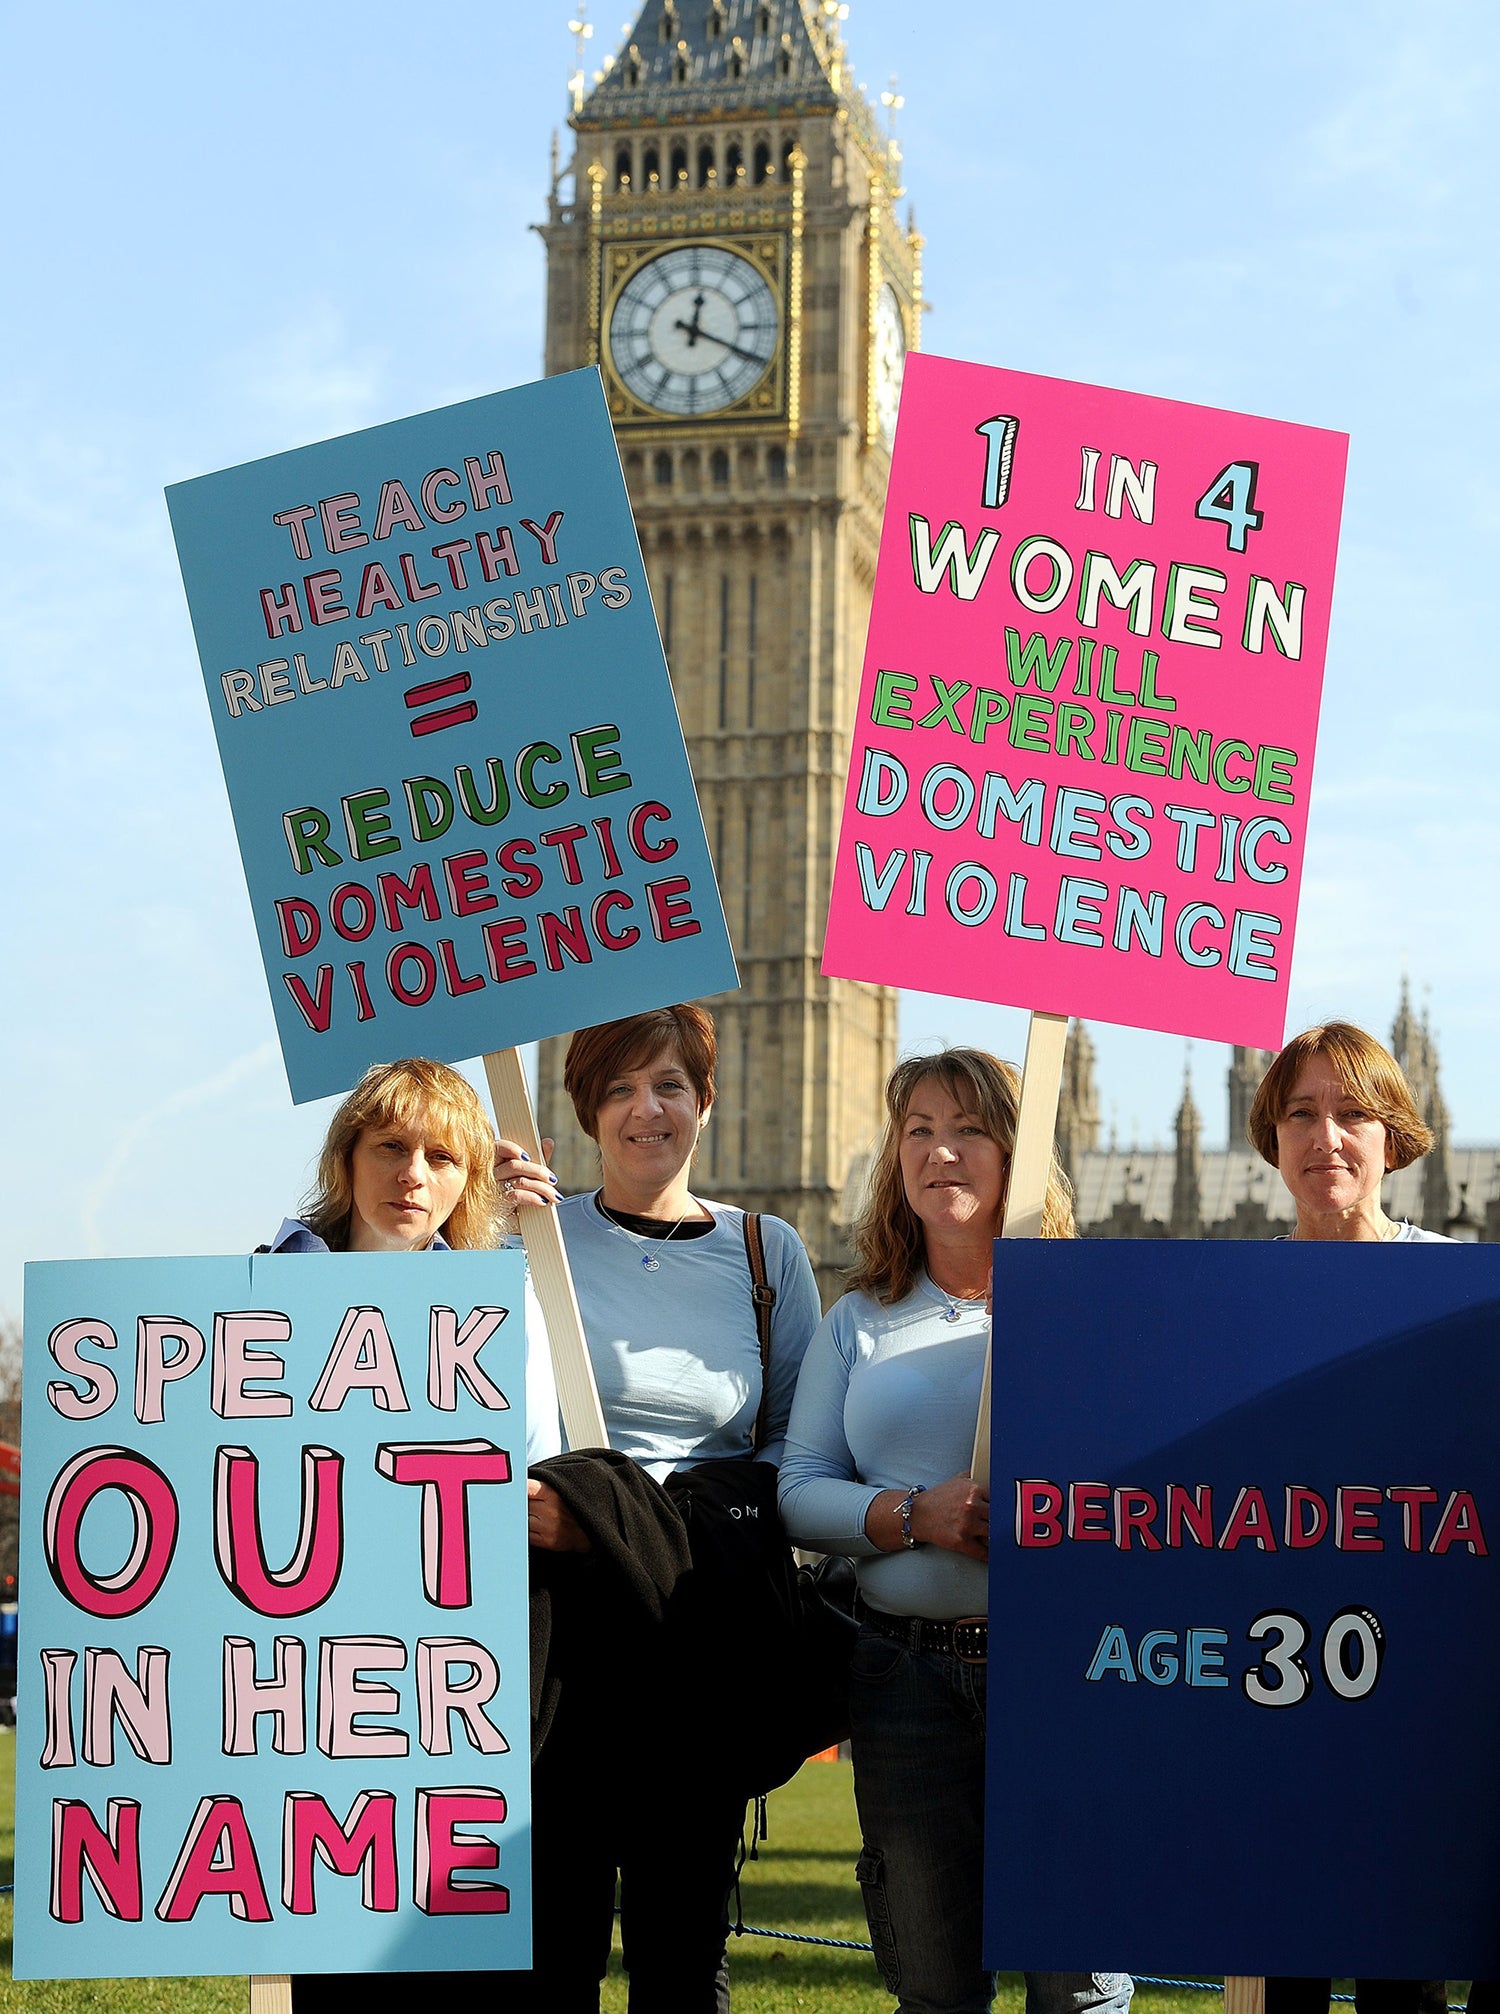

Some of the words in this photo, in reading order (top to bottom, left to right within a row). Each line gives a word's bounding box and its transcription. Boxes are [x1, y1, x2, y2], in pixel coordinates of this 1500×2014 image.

[273, 450, 514, 560] TEACH
[975, 414, 1020, 509] 1
[1075, 445, 1158, 525] IN
[1194, 461, 1264, 554] 4
[220, 567, 632, 718] RELATIONSHIPS
[259, 511, 565, 639] HEALTHY
[908, 512, 1307, 661] WOMEN
[871, 669, 1298, 805] EXPERIENCE
[1004, 626, 1176, 712] WILL
[282, 724, 632, 874] REDUCE
[857, 747, 1292, 885] DOMESTIC
[274, 801, 679, 958] DOMESTIC
[854, 841, 1282, 982] VIOLENCE
[283, 875, 702, 1032] VIOLENCE
[47, 1305, 510, 1424] SPEAK
[42, 1439, 512, 1619] OUT
[1014, 1477, 1489, 1557] BERNADETA
[40, 1646, 172, 1770] IN
[221, 1635, 510, 1759] HER
[1084, 1621, 1230, 1689] AGE
[1241, 1603, 1386, 1710] 30
[49, 1786, 511, 1924] NAME
